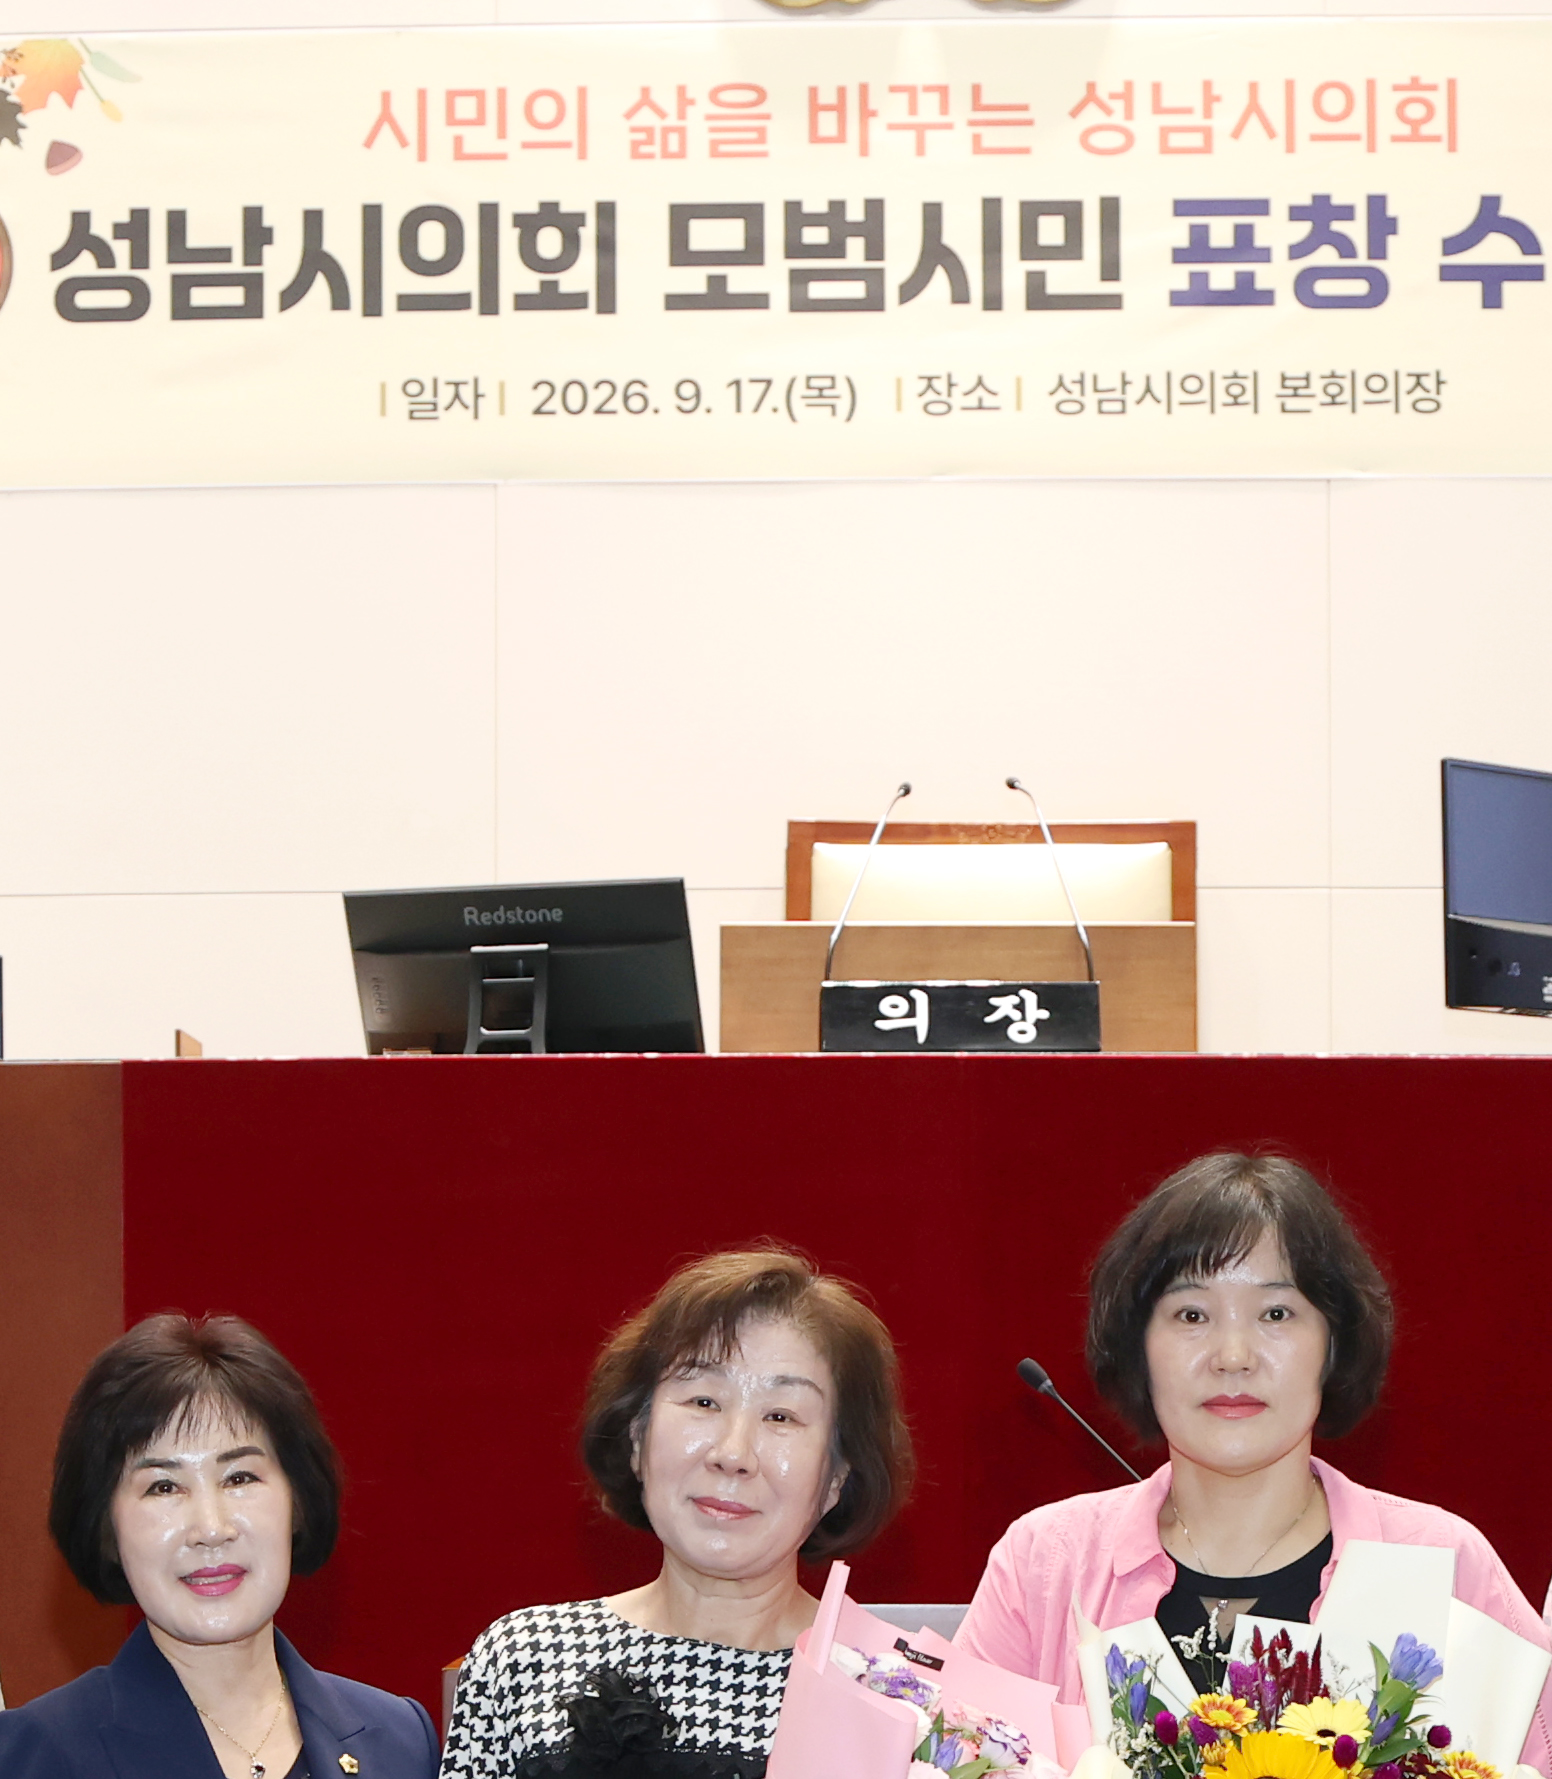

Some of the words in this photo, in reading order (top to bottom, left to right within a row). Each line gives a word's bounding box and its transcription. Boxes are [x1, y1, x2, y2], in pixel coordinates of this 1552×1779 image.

[362, 85, 588, 164] 시민의
[622, 81, 773, 161] 삶을
[807, 81, 1036, 158] 바꾸는
[1067, 75, 1459, 157] 성남시의회
[49, 200, 617, 324] 성남시의회
[664, 196, 1123, 314] 모범시민
[1169, 194, 1398, 310] 표창
[531, 378, 661, 417] 2026.
[673, 378, 713, 415] 9.
[726, 374, 857, 424] 17.(목)
[1048, 370, 1260, 416] 성남시의회
[1274, 369, 1448, 415] 본회의장
[463, 904, 564, 926] Redstone
